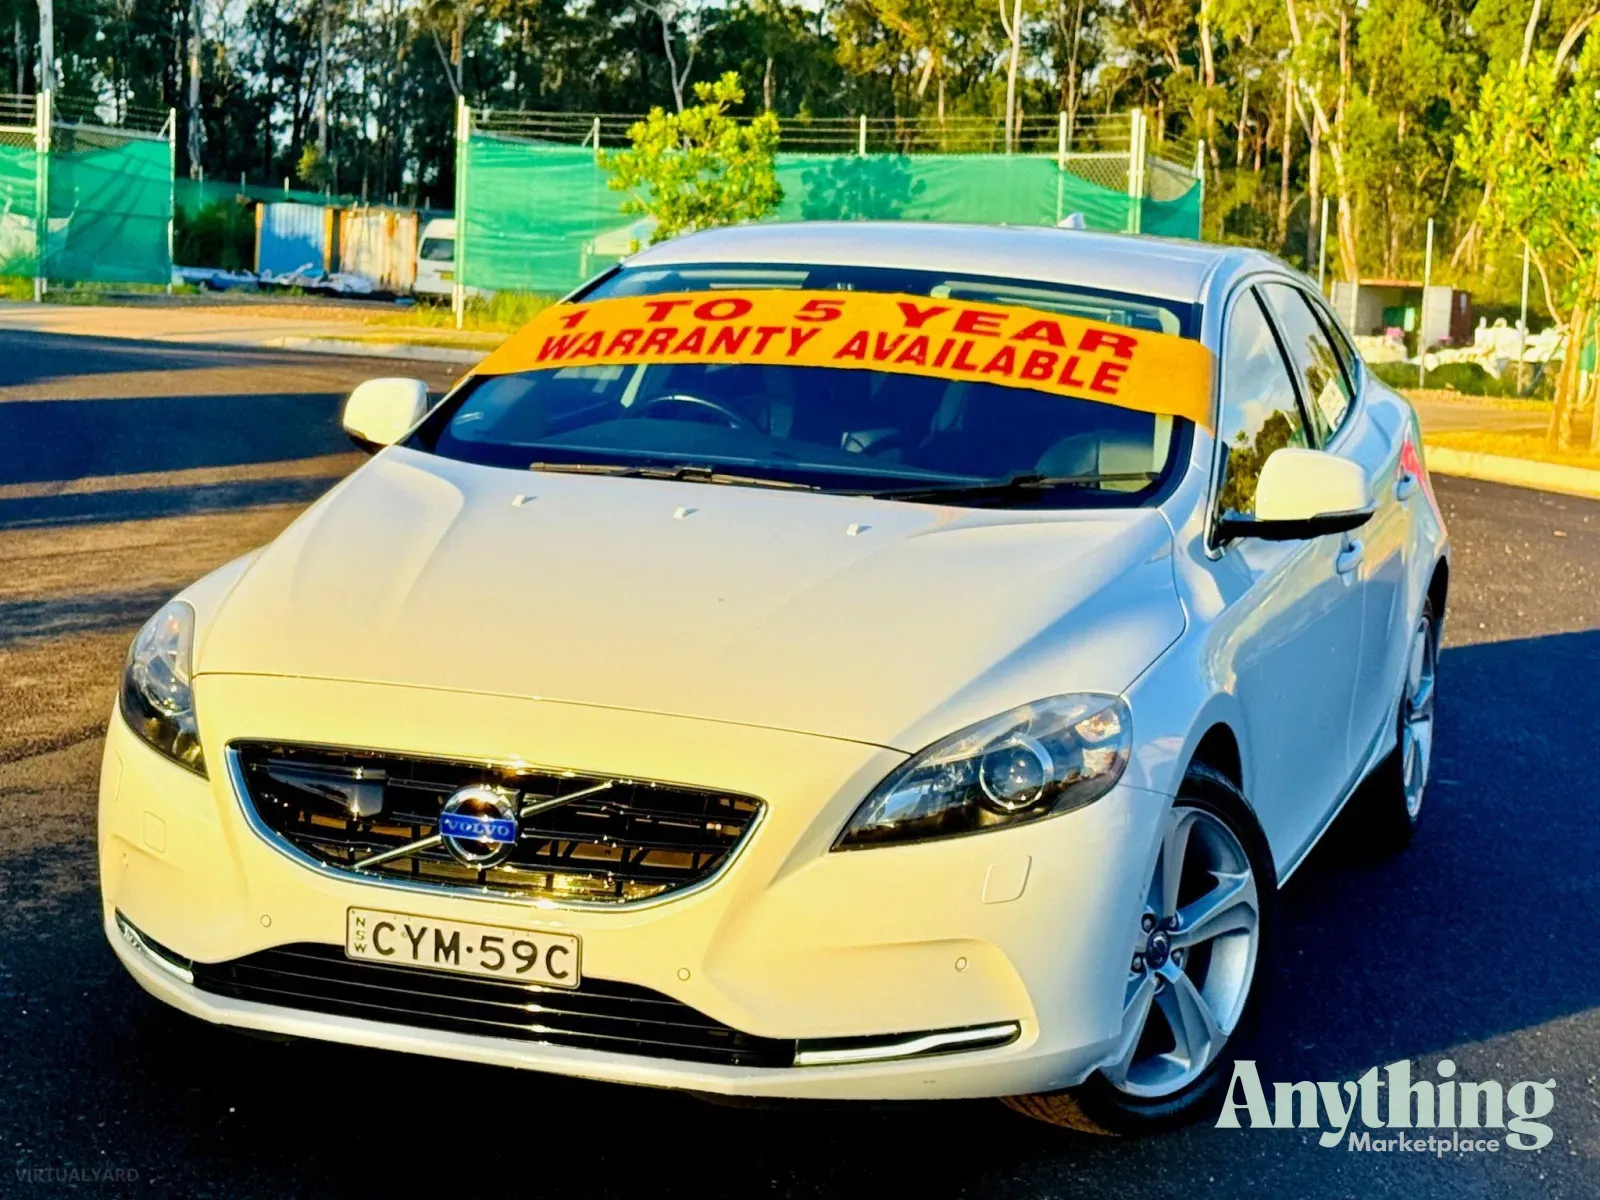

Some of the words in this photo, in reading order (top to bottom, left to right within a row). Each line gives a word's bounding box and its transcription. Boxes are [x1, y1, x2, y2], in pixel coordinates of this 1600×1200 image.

[559, 309, 591, 329] 1
[643, 298, 754, 323] TO
[793, 299, 846, 323] 5
[896, 301, 1140, 360] YEAR
[535, 326, 823, 363] WARRANTY
[834, 330, 1130, 395] AVAILABLE
[444, 819, 510, 837] VOLVO
[354, 916, 367, 954] NSW
